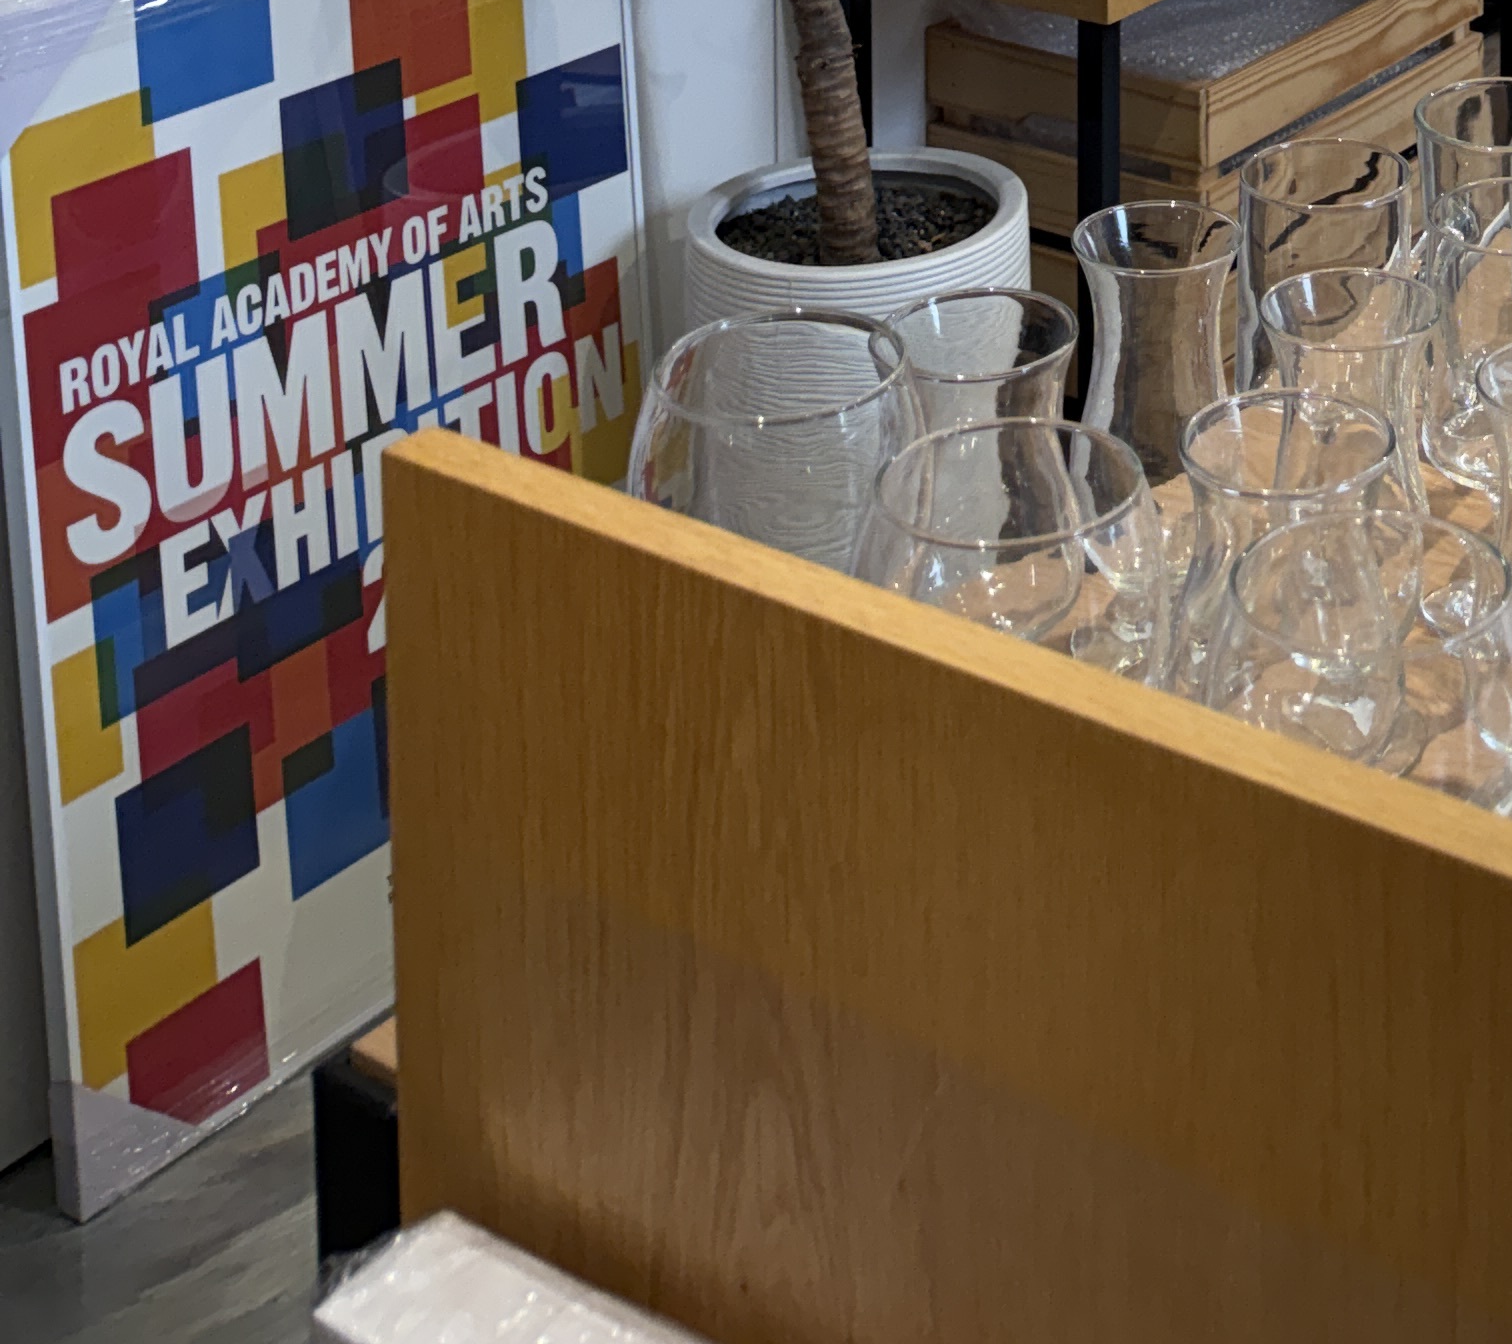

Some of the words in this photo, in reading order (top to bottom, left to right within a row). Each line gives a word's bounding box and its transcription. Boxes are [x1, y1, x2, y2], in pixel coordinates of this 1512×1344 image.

[59, 313, 200, 415] ROYAL
[211, 225, 393, 356] ACADEMY
[402, 209, 448, 266] OF
[459, 166, 549, 245] ARTS
[63, 219, 567, 566] SUMMER
